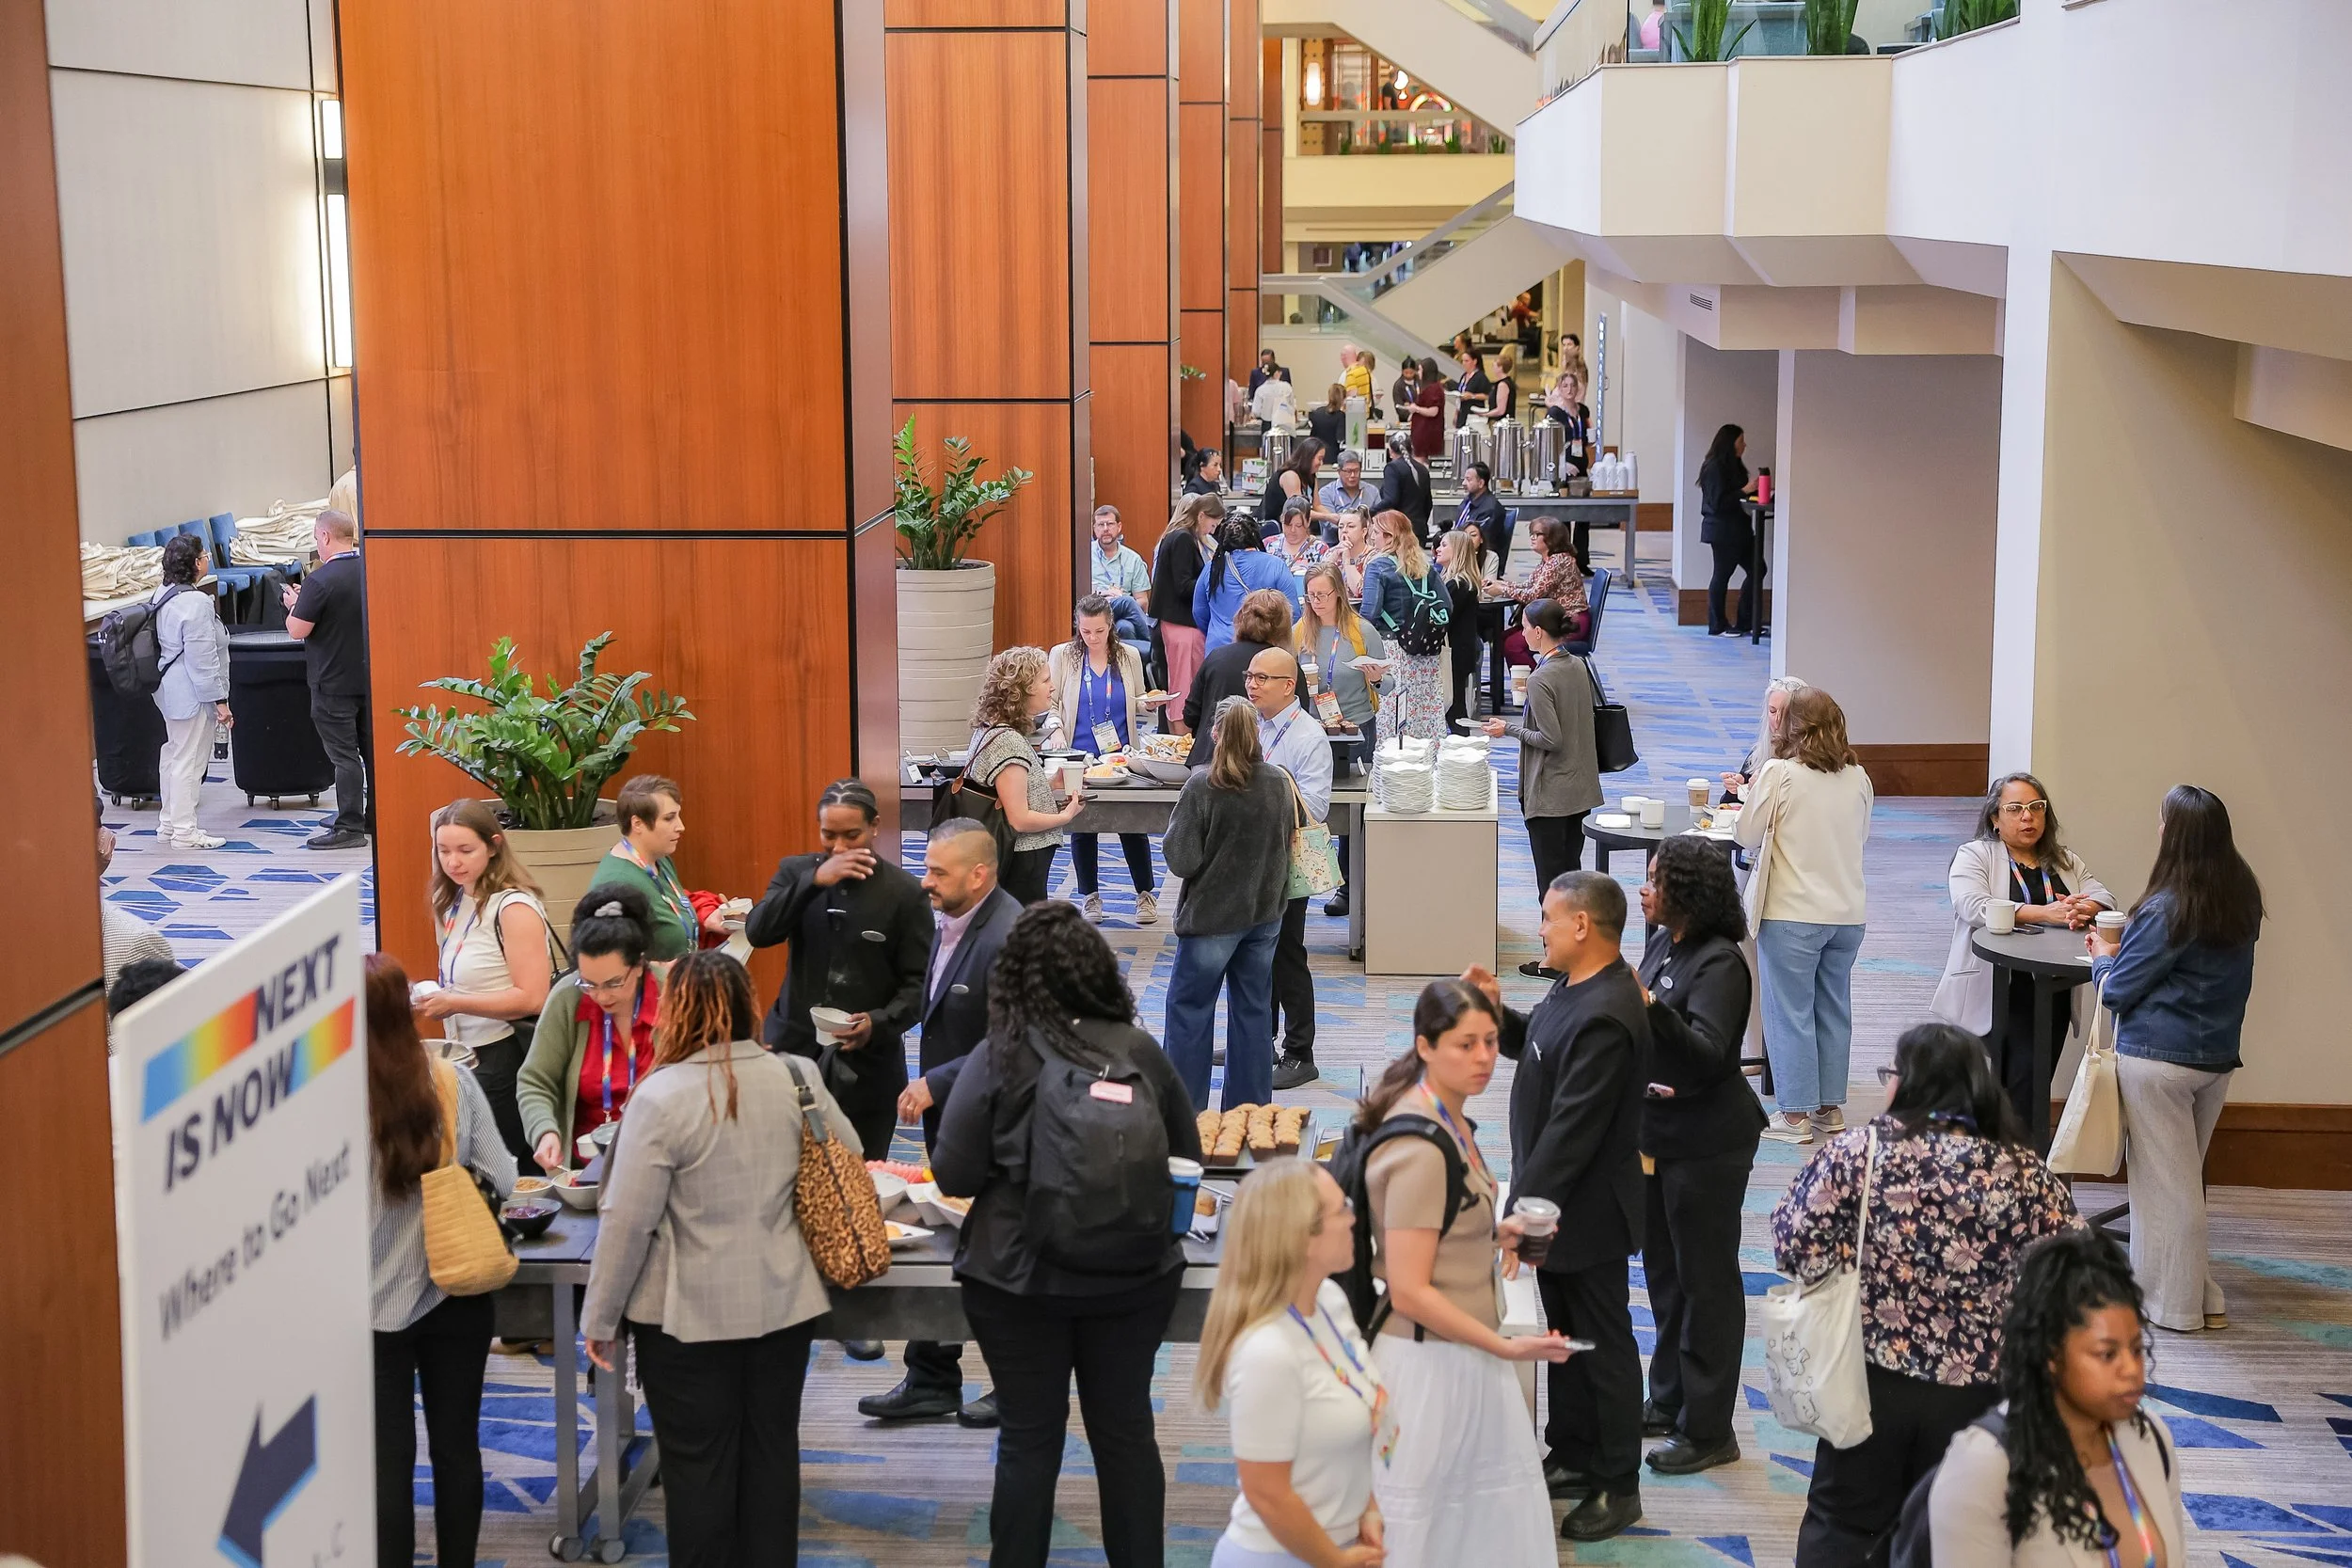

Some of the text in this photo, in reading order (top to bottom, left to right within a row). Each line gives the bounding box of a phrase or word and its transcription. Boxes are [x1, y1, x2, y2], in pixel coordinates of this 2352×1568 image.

[252, 931, 341, 1042] NEXT
[165, 1037, 301, 1193] IS NOW
[158, 1139, 350, 1341] Where to Go Next
